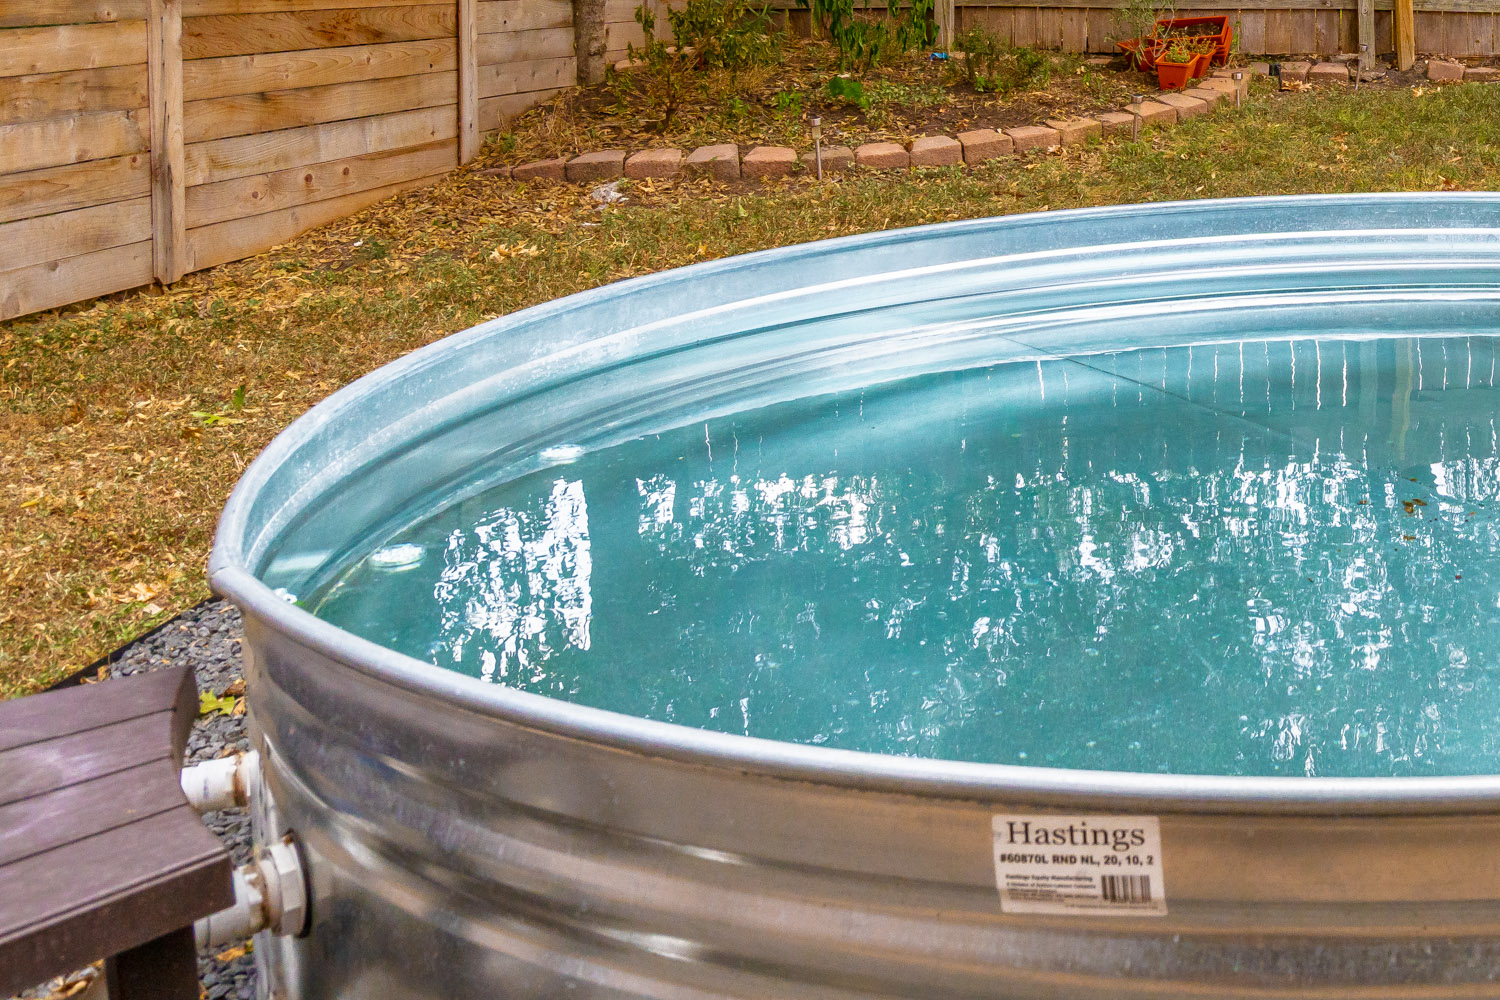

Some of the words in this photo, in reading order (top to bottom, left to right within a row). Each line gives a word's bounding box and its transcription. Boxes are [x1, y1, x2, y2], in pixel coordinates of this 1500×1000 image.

[1006, 820, 1146, 852] Hastings
[1052, 854, 1077, 865] RND
[1080, 855, 1101, 867] NL,
[1103, 855, 1122, 867] 20,
[1125, 855, 1143, 867] 10,
[1146, 855, 1154, 866] 2
